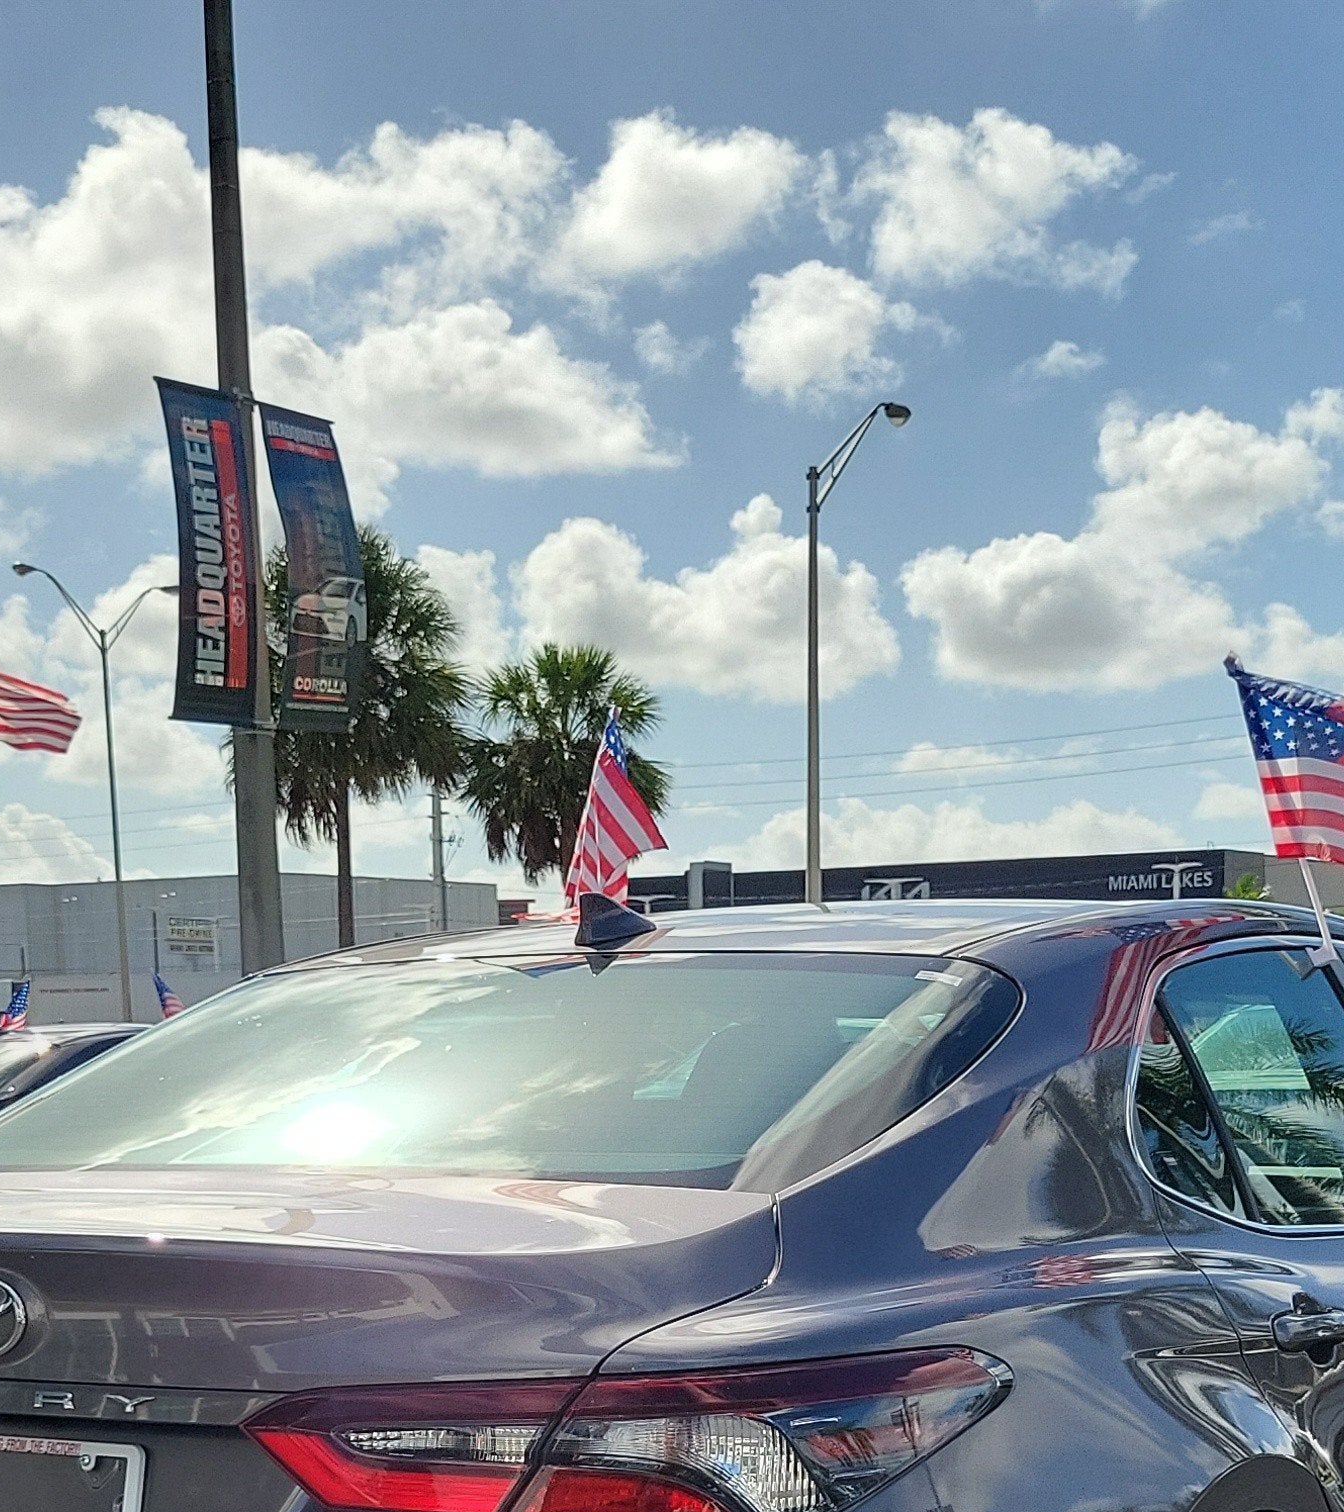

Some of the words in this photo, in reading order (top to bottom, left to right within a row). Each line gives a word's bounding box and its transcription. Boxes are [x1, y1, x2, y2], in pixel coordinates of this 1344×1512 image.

[182, 417, 226, 687] HEADQUARTER
[223, 494, 244, 590] TOYOTA
[293, 676, 348, 694] COROLLA
[1108, 874, 1157, 892] MIAMI
